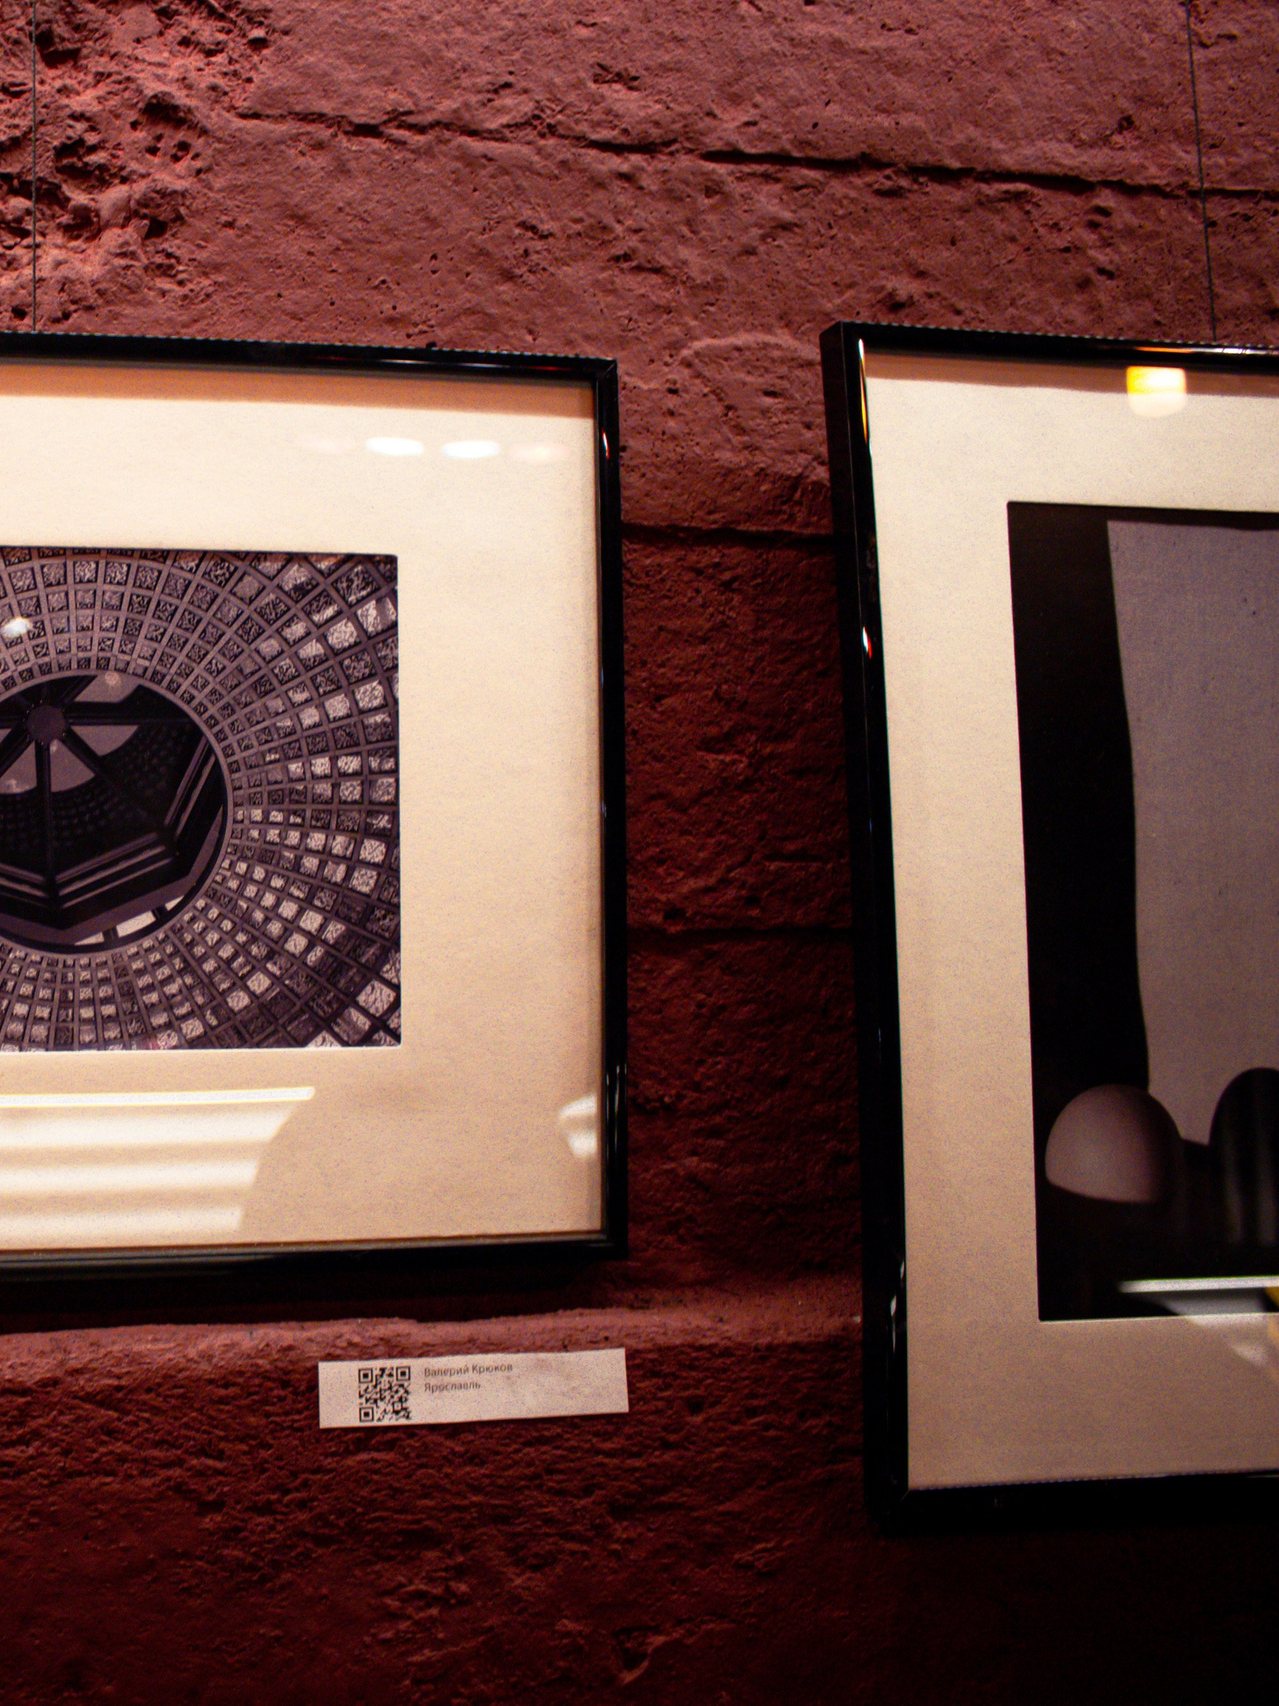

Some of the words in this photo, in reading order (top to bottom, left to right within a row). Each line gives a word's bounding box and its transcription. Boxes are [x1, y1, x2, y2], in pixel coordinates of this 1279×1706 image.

[424, 1364, 469, 1378] Валерий
[472, 1363, 513, 1375] Крюков
[424, 1381, 481, 1394] Ярославль
